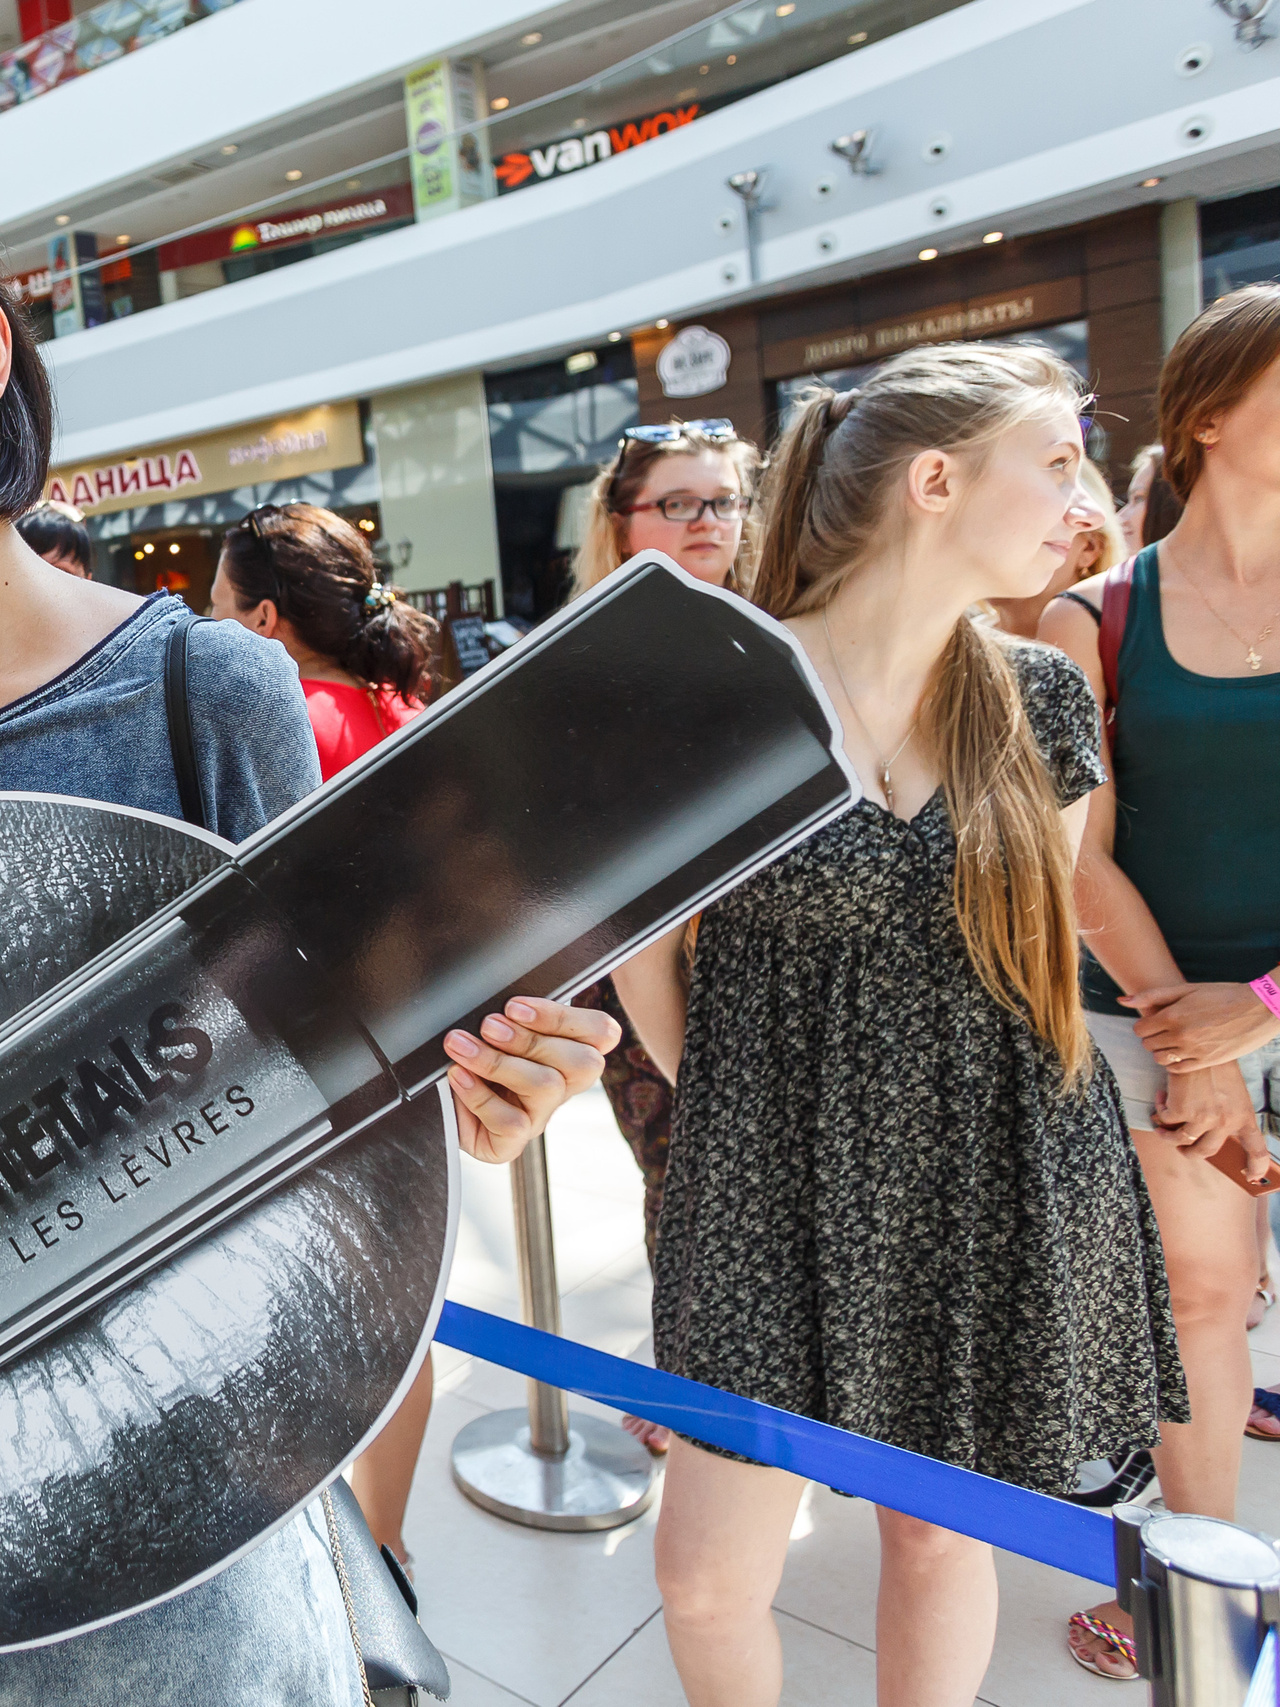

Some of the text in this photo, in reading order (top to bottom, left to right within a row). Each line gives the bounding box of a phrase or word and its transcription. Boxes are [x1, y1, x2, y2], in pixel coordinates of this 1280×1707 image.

[48, 449, 202, 507] АДНИЦА
[8, 1199, 85, 1264] LES
[97, 1085, 256, 1204] LÈVRES
